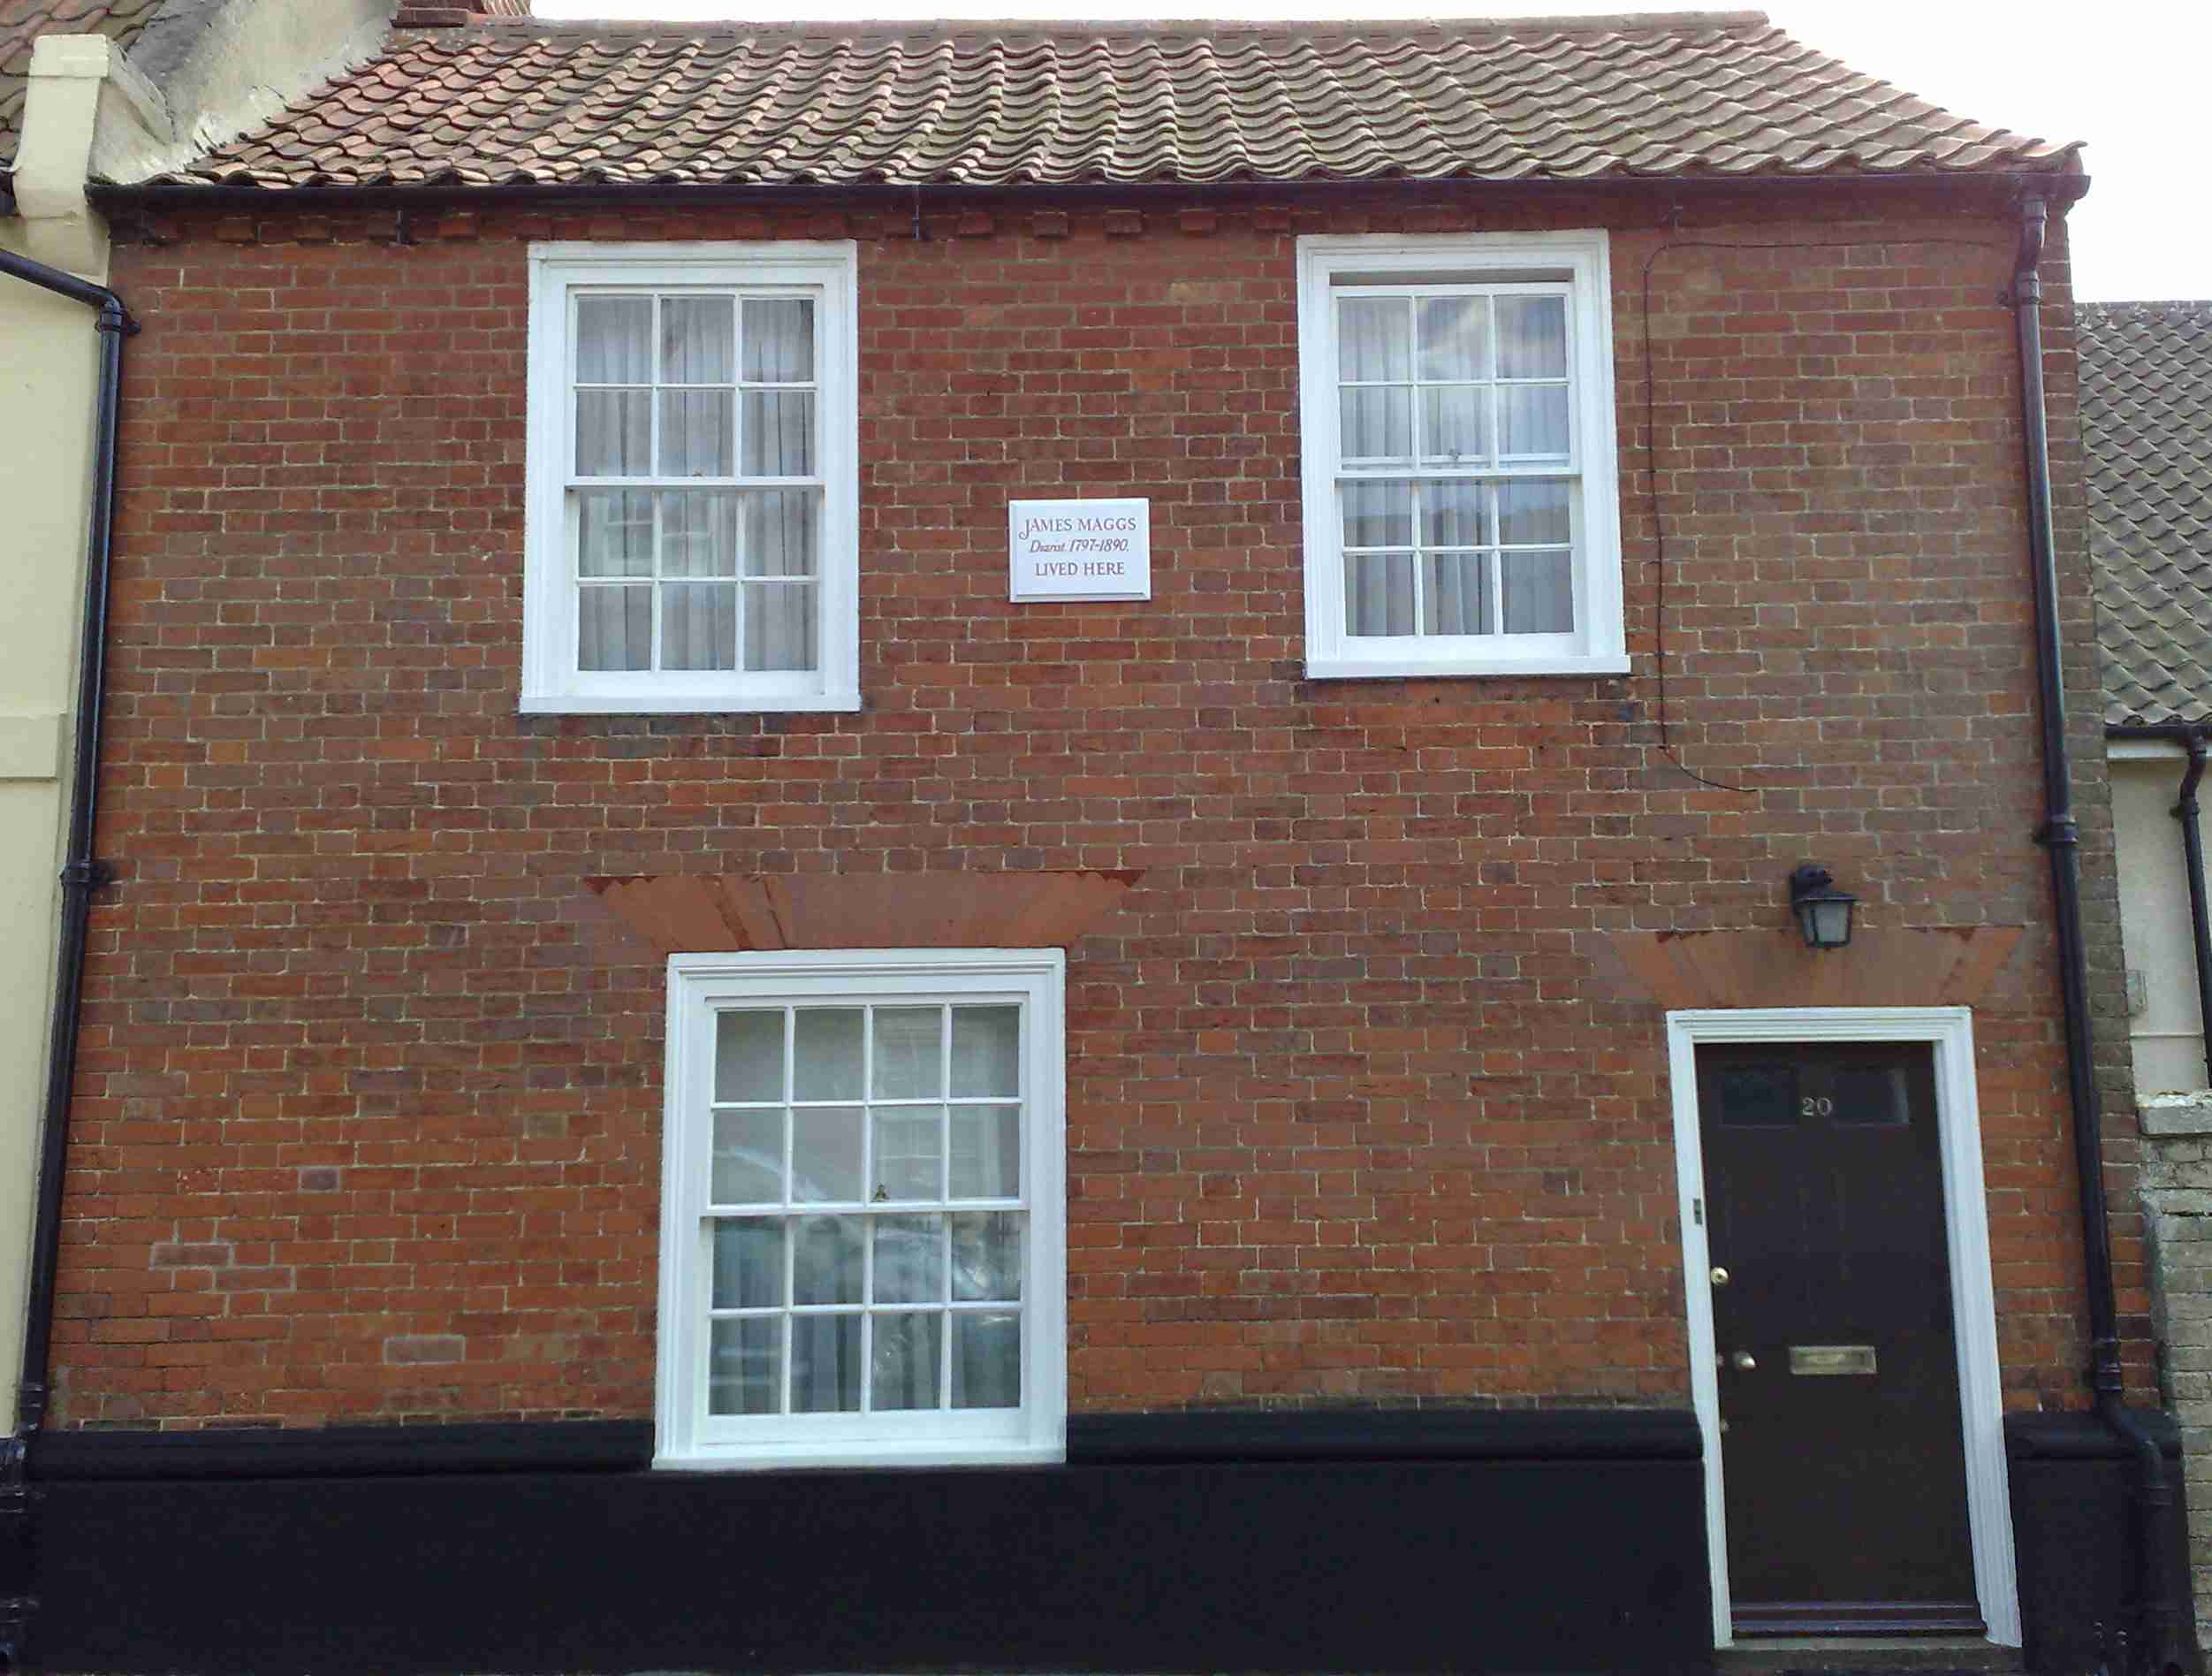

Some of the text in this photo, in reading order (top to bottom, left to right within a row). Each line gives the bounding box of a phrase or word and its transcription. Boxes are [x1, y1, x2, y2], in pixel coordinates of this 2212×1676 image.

[1018, 517, 1136, 540] JAMES MAGGS
[1036, 561, 1125, 576] LIVED HERE
[1802, 1096, 1833, 1116] 20
